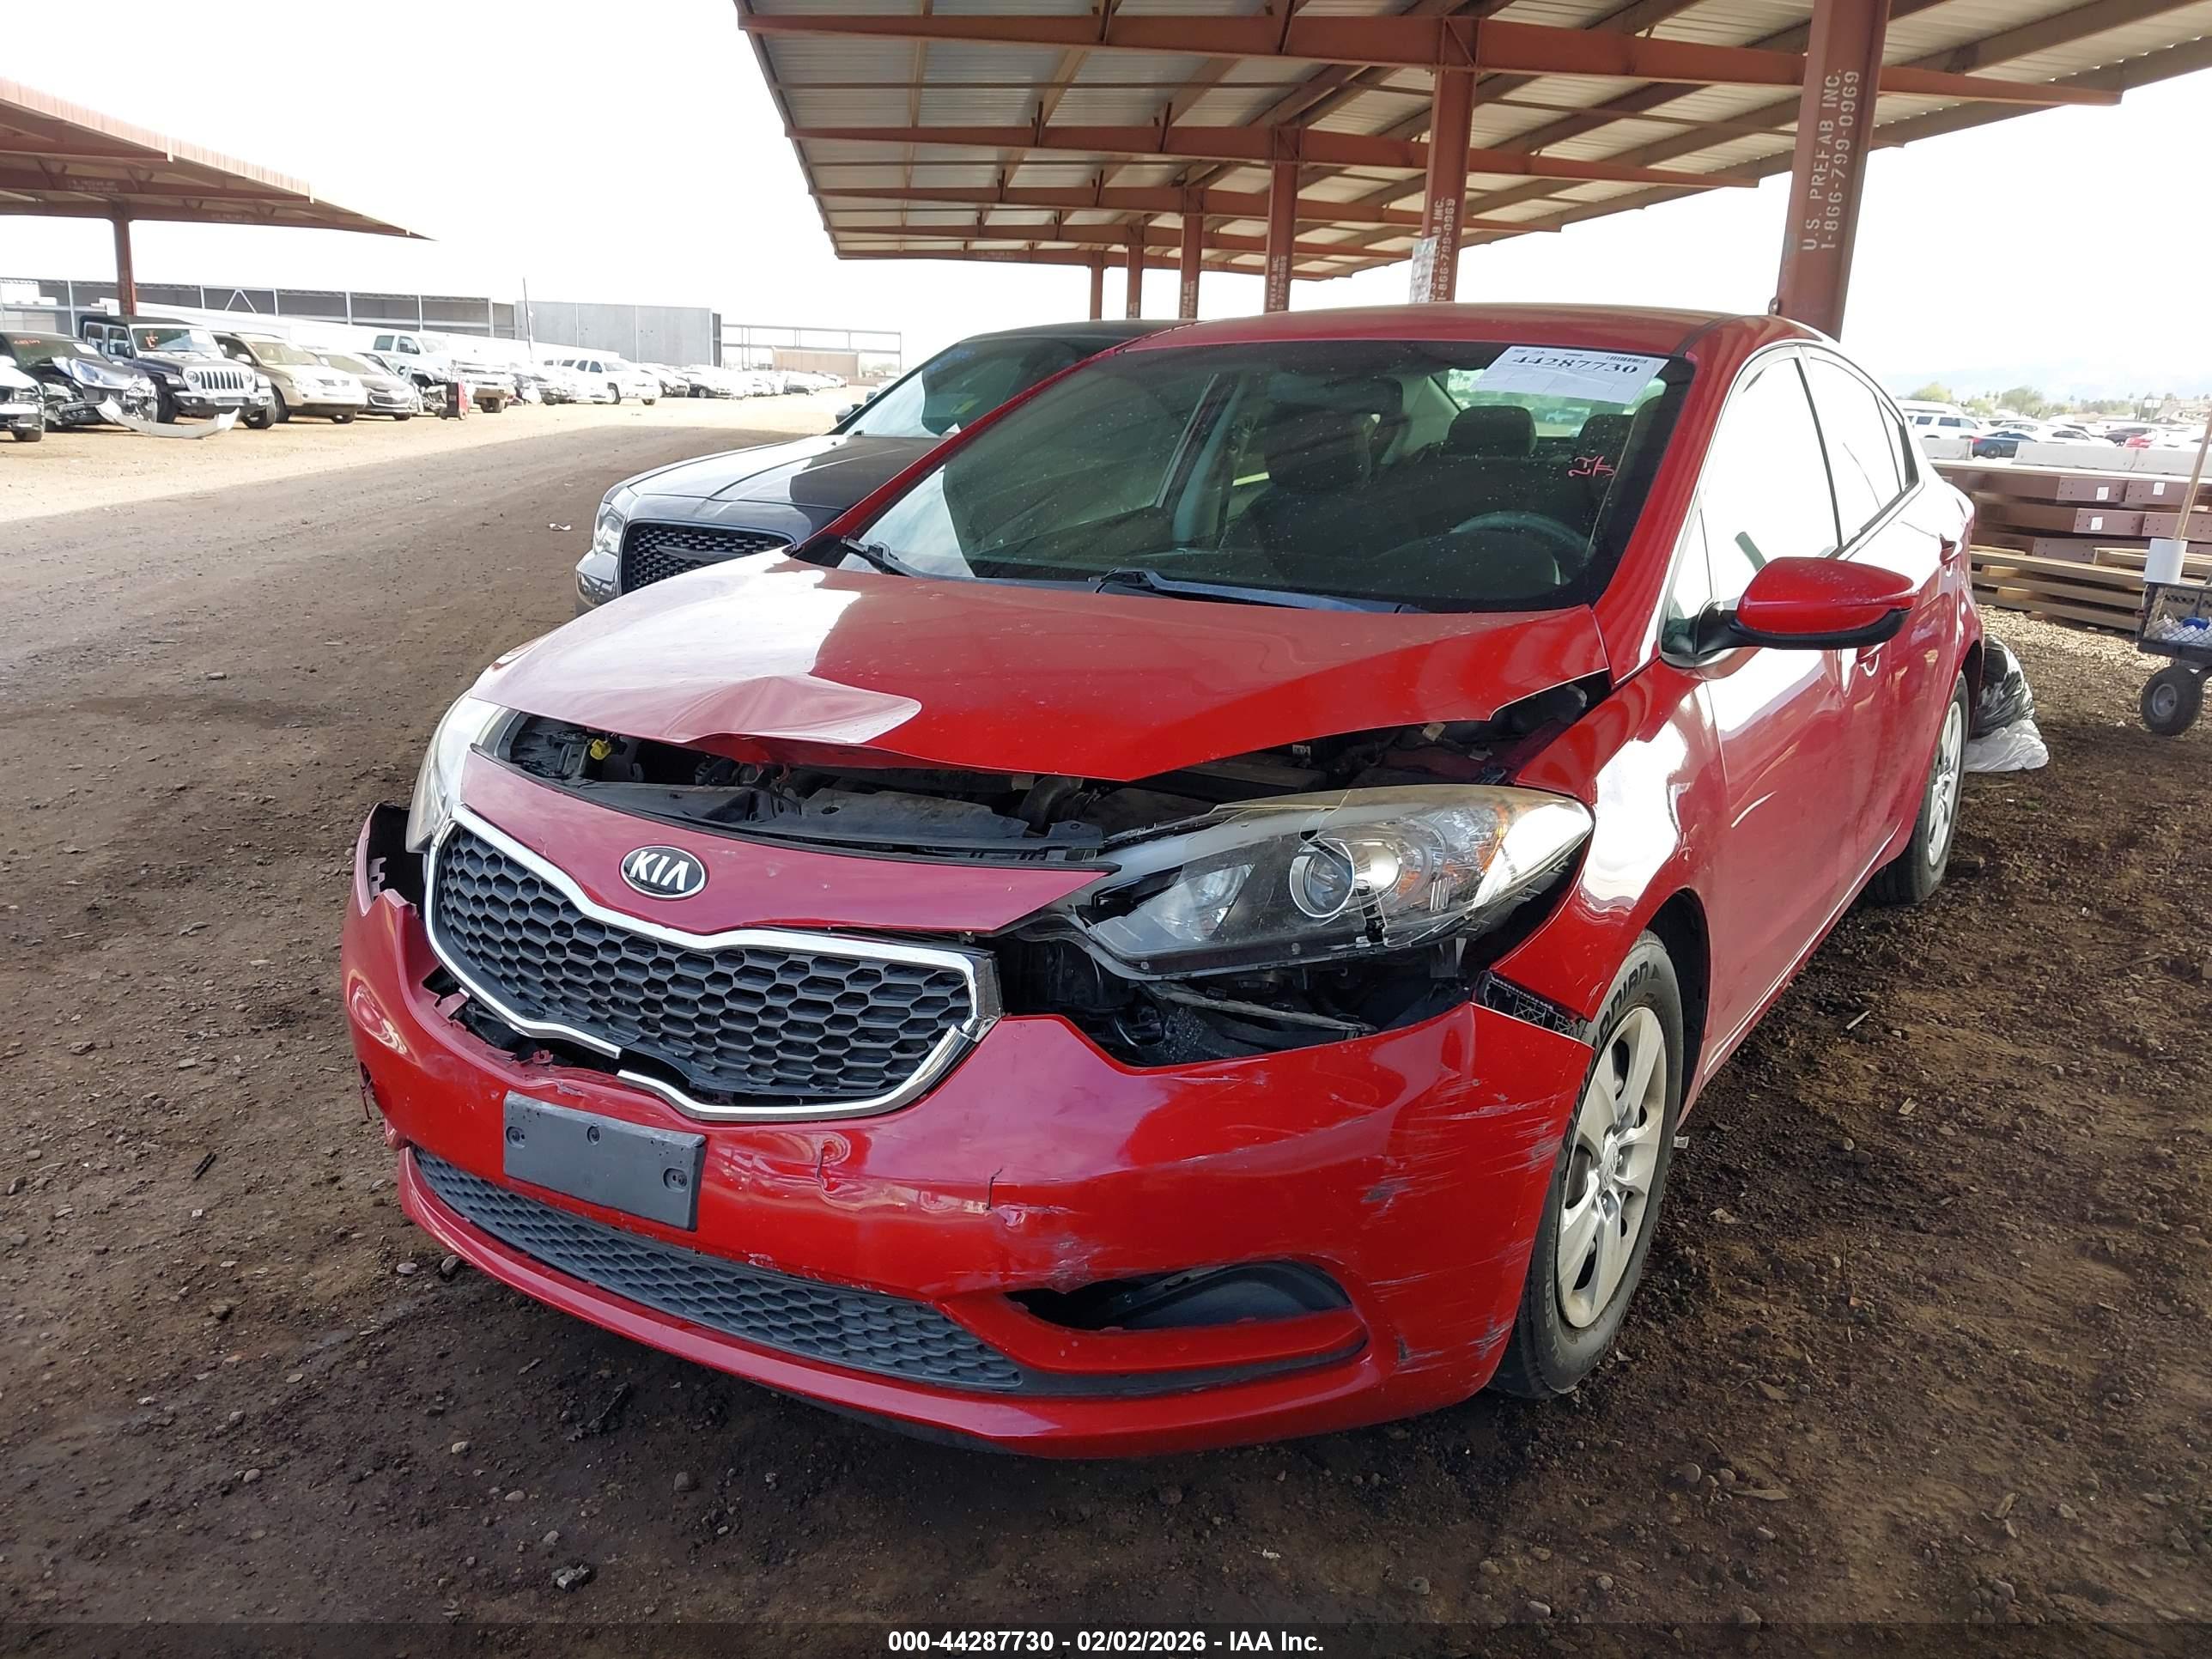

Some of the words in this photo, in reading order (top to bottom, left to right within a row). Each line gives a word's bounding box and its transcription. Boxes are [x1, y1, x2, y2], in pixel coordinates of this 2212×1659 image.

[1821, 68, 1843, 108] INC.
[1809, 119, 1836, 200] PREFAB
[1820, 70, 1861, 250] 1-866-799-0969
[1437, 198, 1456, 301] 1-866-799-0969
[1802, 212, 1823, 251] U.S.
[1511, 356, 1639, 374] 44287730
[629, 851, 690, 891] KIA
